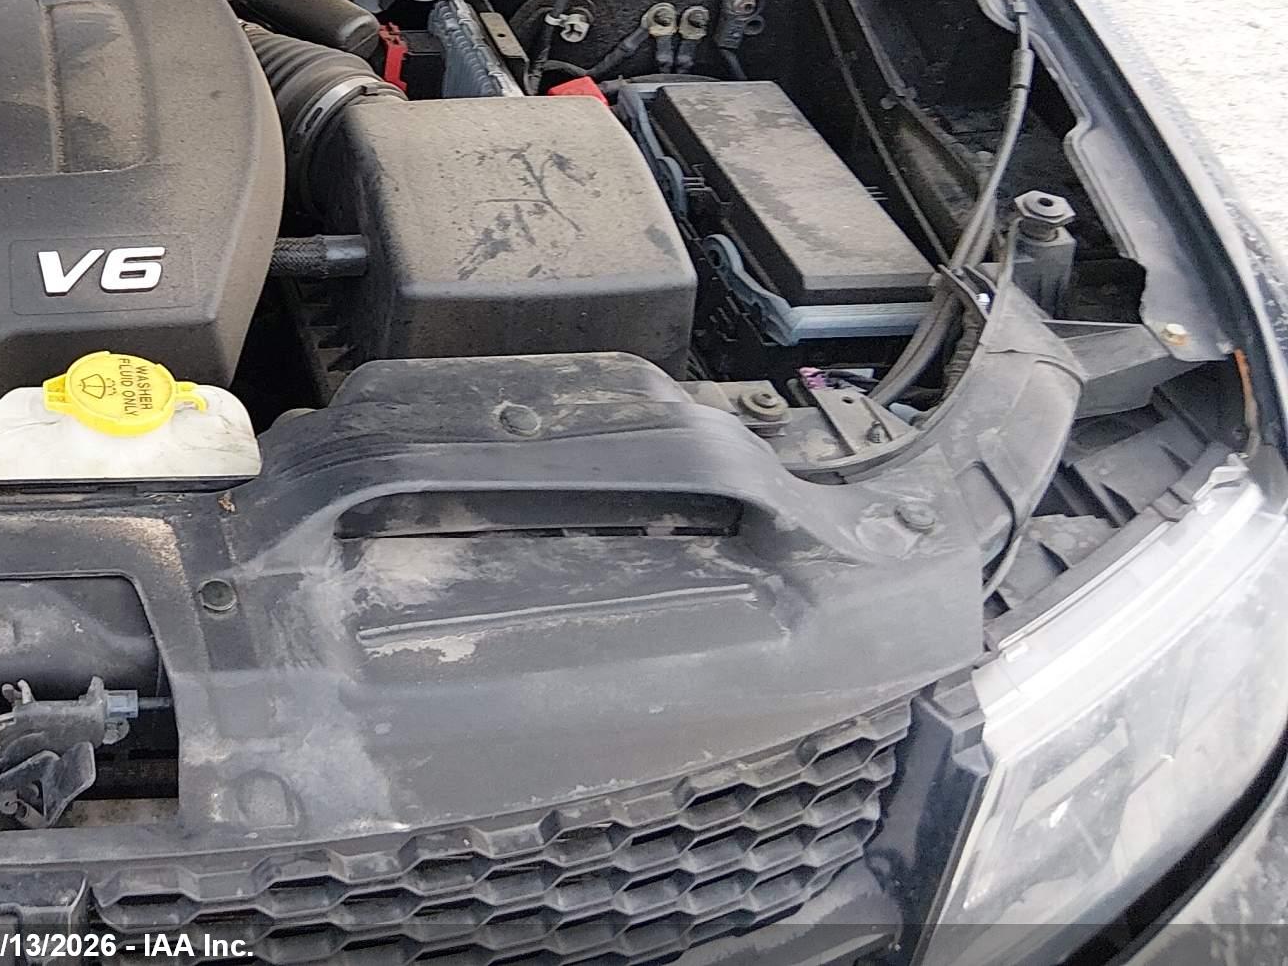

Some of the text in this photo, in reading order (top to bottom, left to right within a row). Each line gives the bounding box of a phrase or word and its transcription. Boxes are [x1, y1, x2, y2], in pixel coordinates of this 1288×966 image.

[37, 246, 166, 297] V6
[118, 358, 139, 417] FLUID ONLY
[135, 366, 153, 410] WASHER
